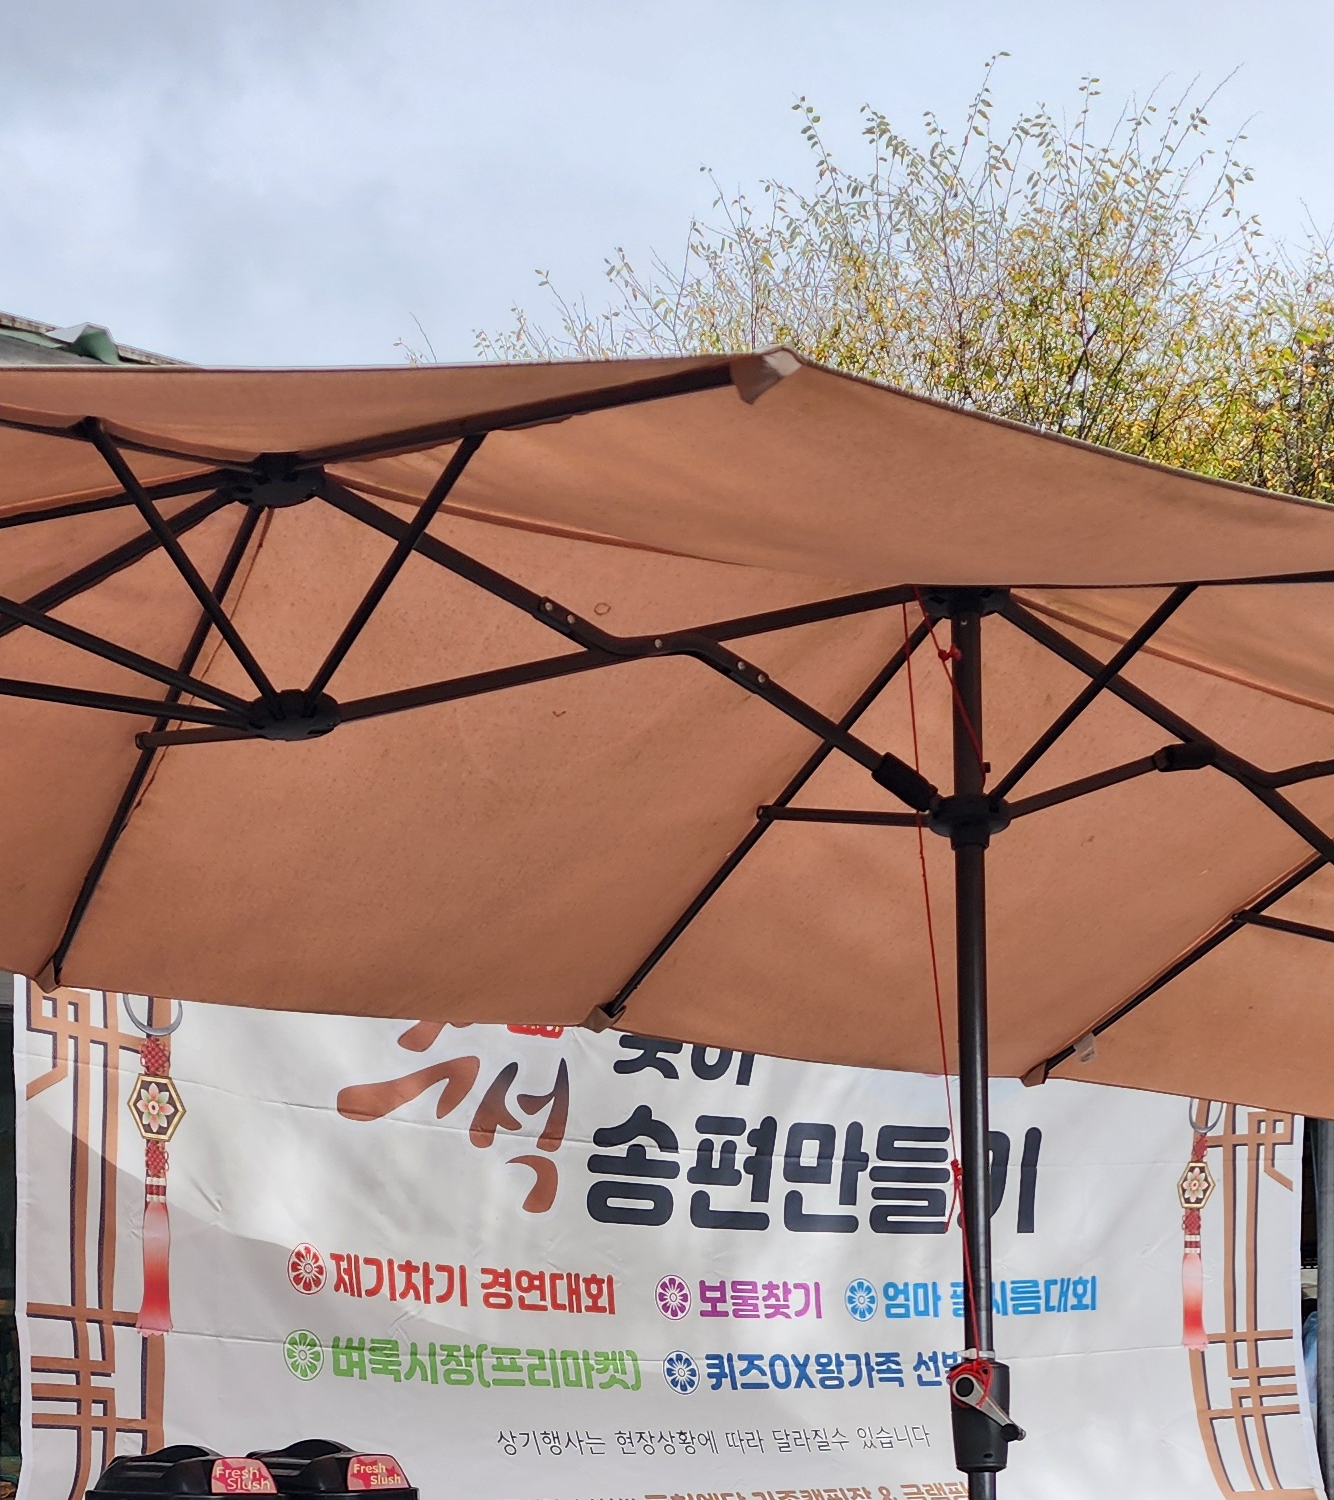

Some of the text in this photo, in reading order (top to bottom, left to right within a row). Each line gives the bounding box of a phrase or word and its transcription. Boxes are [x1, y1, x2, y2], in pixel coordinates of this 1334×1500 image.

[586, 1104, 1043, 1234] 송편만들기
[329, 1252, 617, 1315] 제기차기 경연대회
[699, 1279, 824, 1320] 보물찾기
[882, 1280, 943, 1319] 엄마
[331, 1335, 643, 1392] 벼룩시장(프리마켓)
[705, 1351, 906, 1391] 퀴즈OX왕가족
[496, 1424, 931, 1456] 상기행사는 현장상황에 따라 달라질수 있습니다
[216, 1466, 260, 1479] Fresh
[226, 1477, 271, 1491] Slush
[353, 1463, 386, 1474] Fresh
[370, 1474, 402, 1486] Slush
